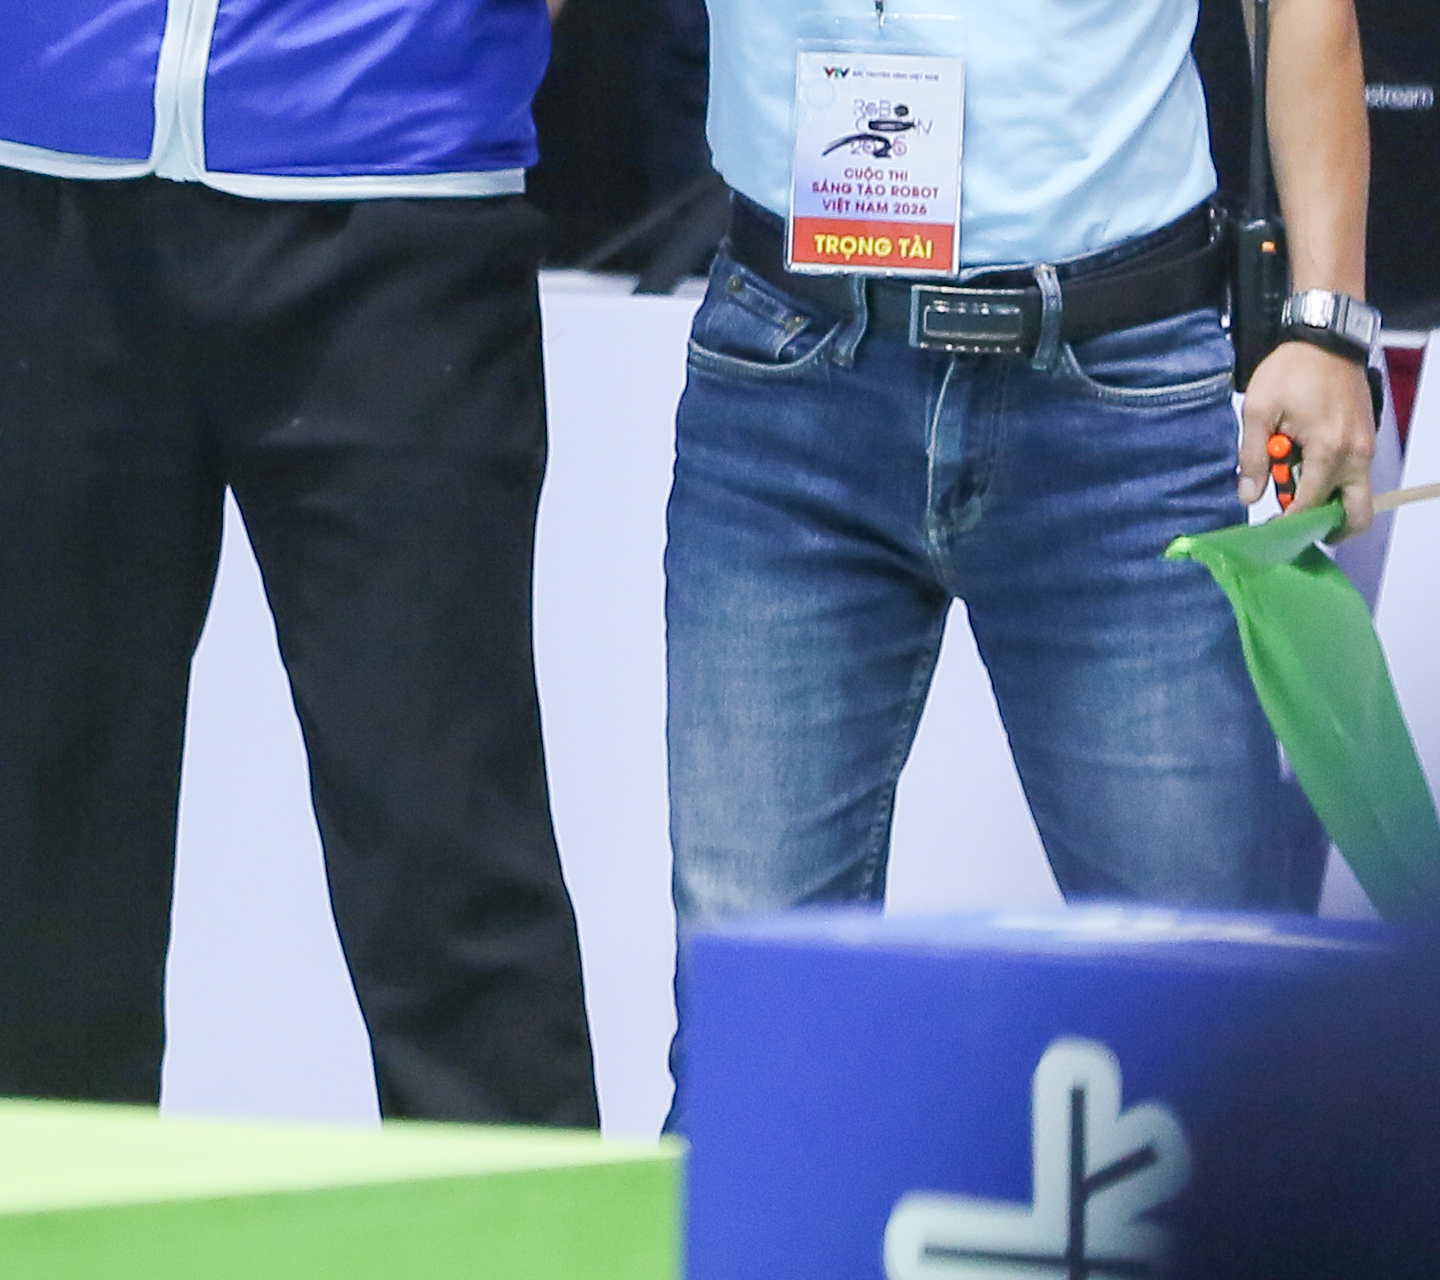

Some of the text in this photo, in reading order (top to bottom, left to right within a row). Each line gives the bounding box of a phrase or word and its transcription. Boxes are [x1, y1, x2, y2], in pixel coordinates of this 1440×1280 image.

[823, 66, 850, 78] VTV
[821, 133, 908, 158] 2026
[844, 167, 908, 183] CUỘC THI
[812, 179, 939, 199] SÁNG TẠO ROBOT
[822, 197, 928, 215] VIỆT NAM 2026
[814, 233, 934, 262] TRỌNG TÀI
